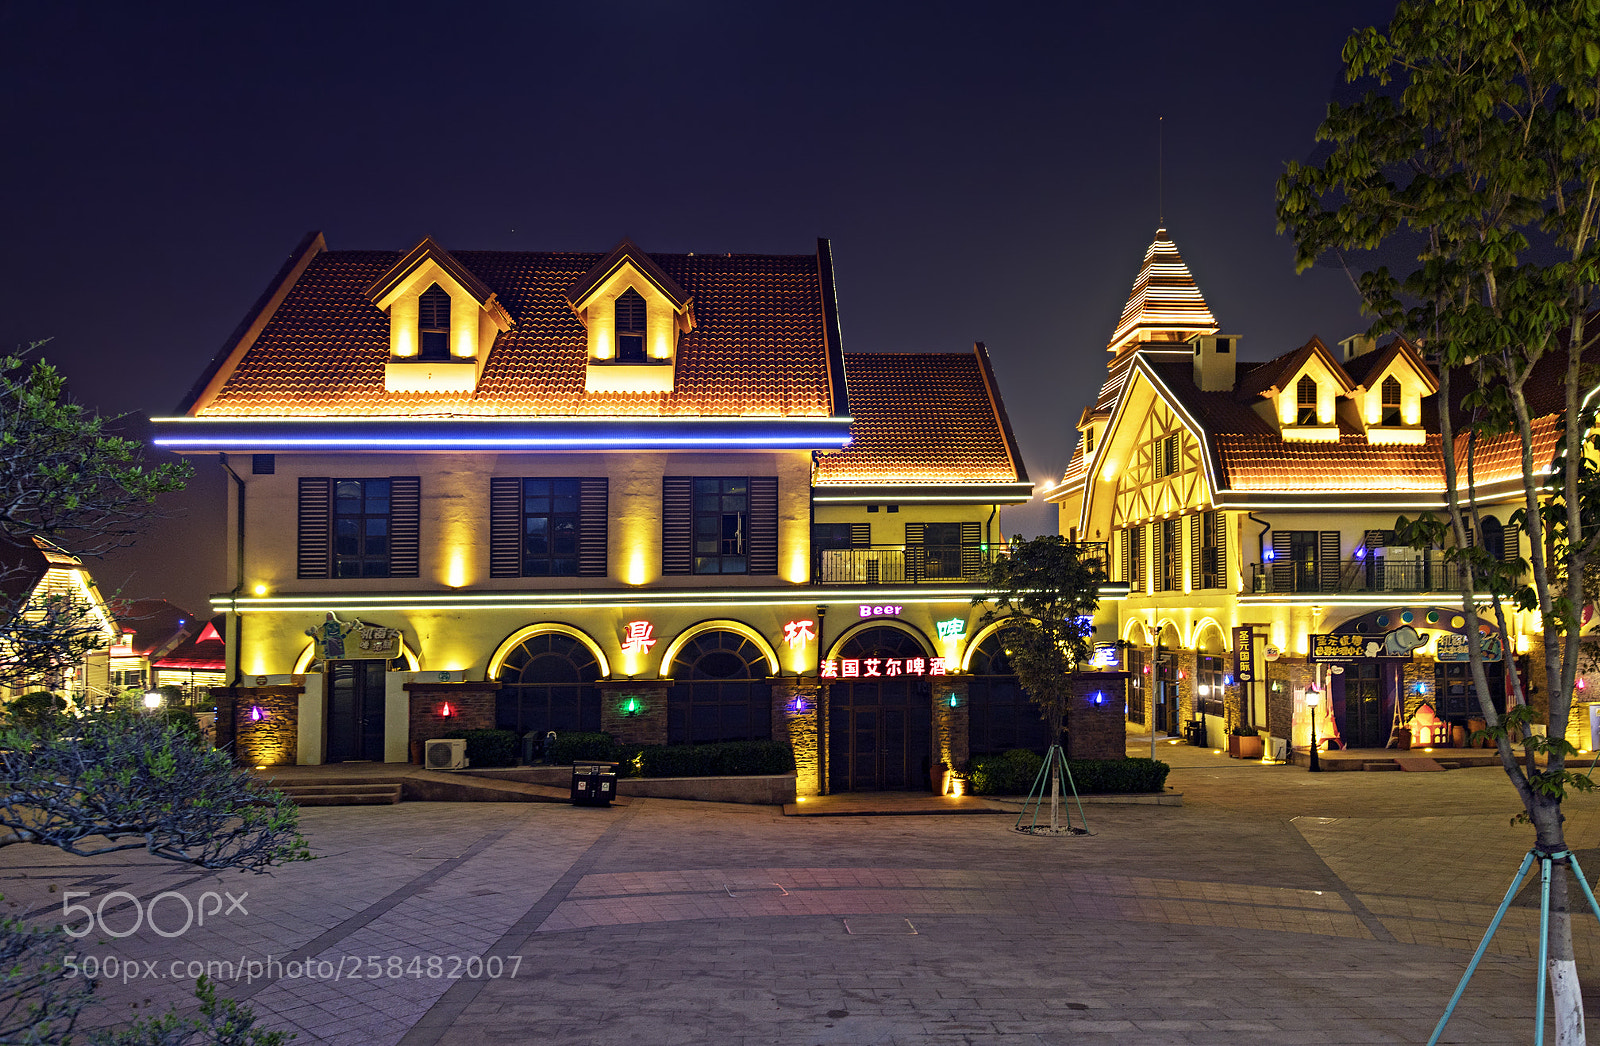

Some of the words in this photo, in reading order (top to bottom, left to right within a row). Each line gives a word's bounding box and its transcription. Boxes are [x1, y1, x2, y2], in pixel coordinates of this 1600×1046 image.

[859, 605, 902, 618] Beer
[784, 620, 815, 650] 杯
[1239, 630, 1250, 672] 圣元国际
[820, 657, 946, 678] 法国艾尔啤酒
